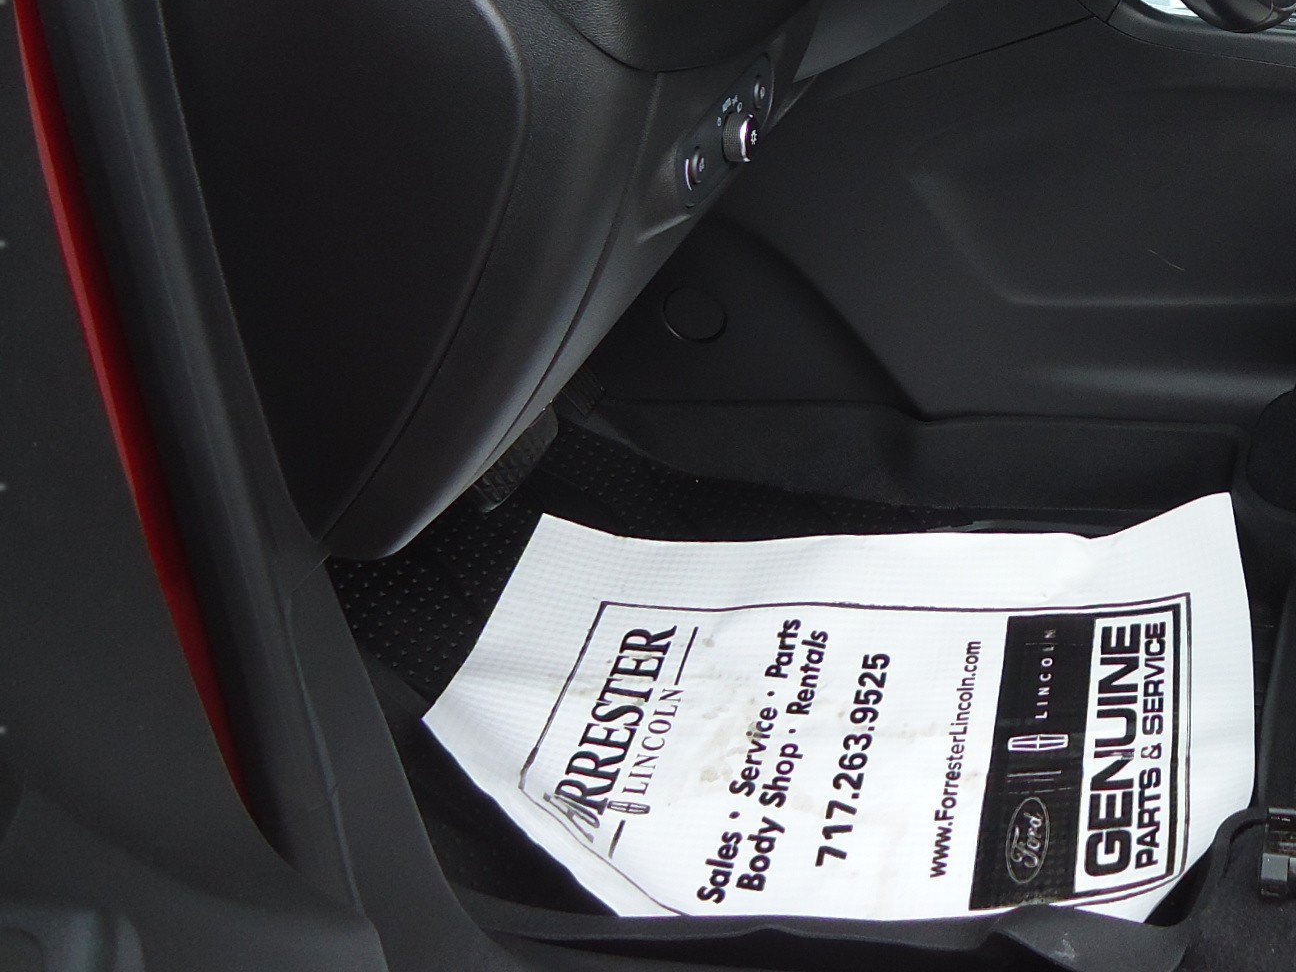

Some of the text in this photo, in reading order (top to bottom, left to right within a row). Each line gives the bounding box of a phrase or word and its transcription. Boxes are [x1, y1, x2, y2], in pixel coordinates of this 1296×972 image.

[622, 687, 685, 796] LINCOLN
[696, 618, 801, 904] Sales Service Parts
[735, 630, 829, 892] Body Shop Rentals
[815, 653, 891, 867] 717.263.9525
[929, 640, 981, 878] www.ForresterLincoln.com
[1034, 628, 1056, 719] LINCOLN
[1084, 622, 1142, 877] GENUINE
[1135, 621, 1167, 870] PARTS & SERVICE
[1010, 812, 1043, 869] Ford
